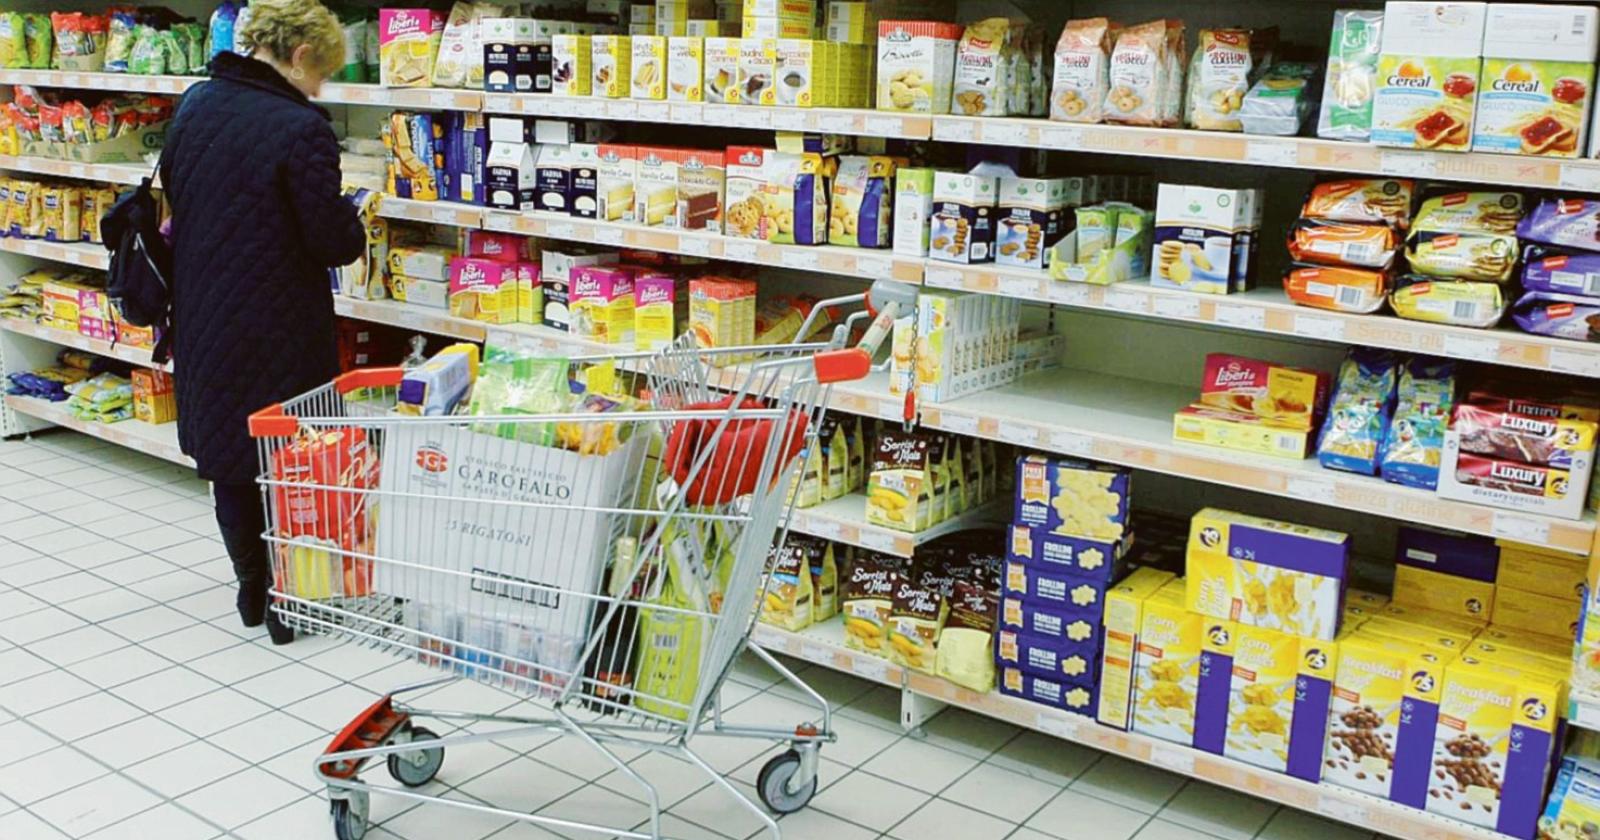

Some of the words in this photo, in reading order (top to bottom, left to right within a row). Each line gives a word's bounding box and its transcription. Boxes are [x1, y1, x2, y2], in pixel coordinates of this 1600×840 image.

[1501, 412, 1556, 437] Luxury
[458, 464, 570, 500] GAROFALO
[1490, 460, 1545, 485] Luxury
[461, 521, 532, 547] RIGATONI
